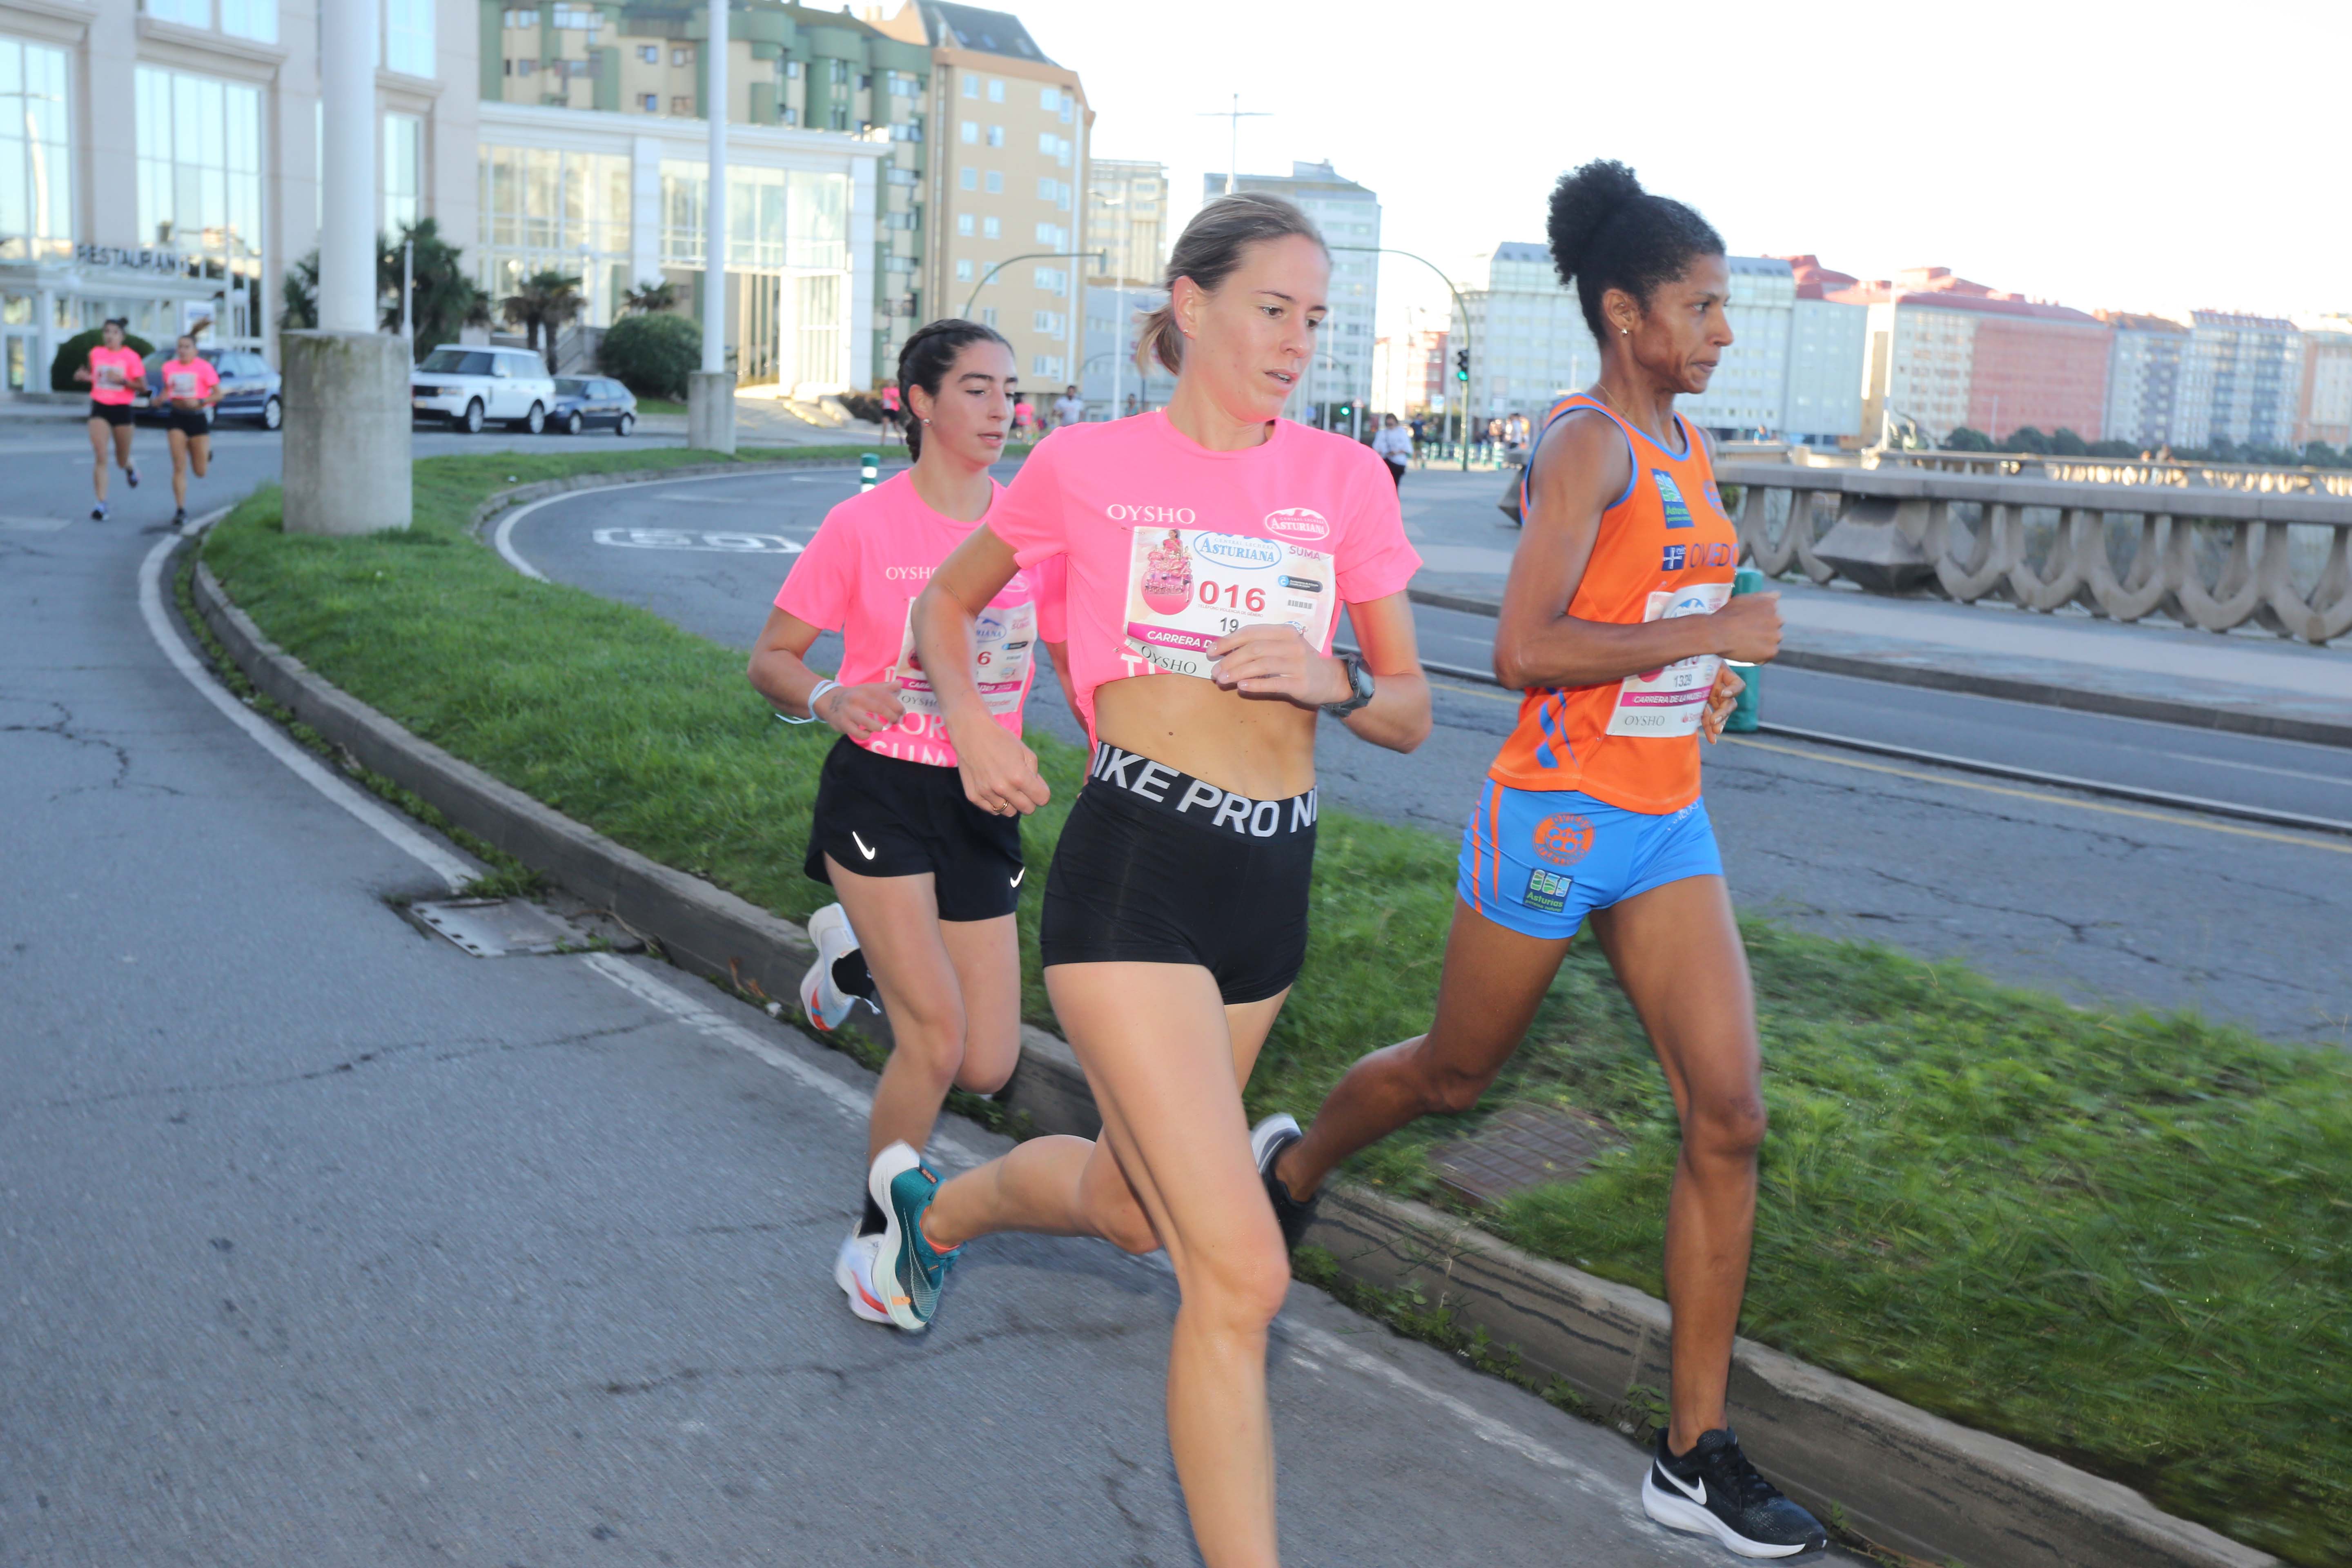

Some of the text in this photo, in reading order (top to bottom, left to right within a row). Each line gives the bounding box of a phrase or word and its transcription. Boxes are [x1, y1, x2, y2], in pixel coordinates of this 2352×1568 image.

[1107, 504, 1196, 524] OYSHO
[1200, 538, 1274, 562] ASTURIANA
[1289, 545, 1321, 561] SUMA
[886, 567, 938, 580] OYSH
[1199, 580, 1266, 612] 016
[1220, 617, 1239, 633] 19
[1147, 630, 1213, 648] CARRERA D
[1142, 646, 1197, 674] OYSHO
[1675, 673, 1693, 688] 1329
[1634, 695, 1668, 704] CARRERA
[1670, 695, 1679, 703] DE
[1624, 715, 1665, 726] OYSHO
[1091, 741, 1180, 803] IKE
[1176, 779, 1281, 837] PRO
[1526, 891, 1564, 907] Asturias
